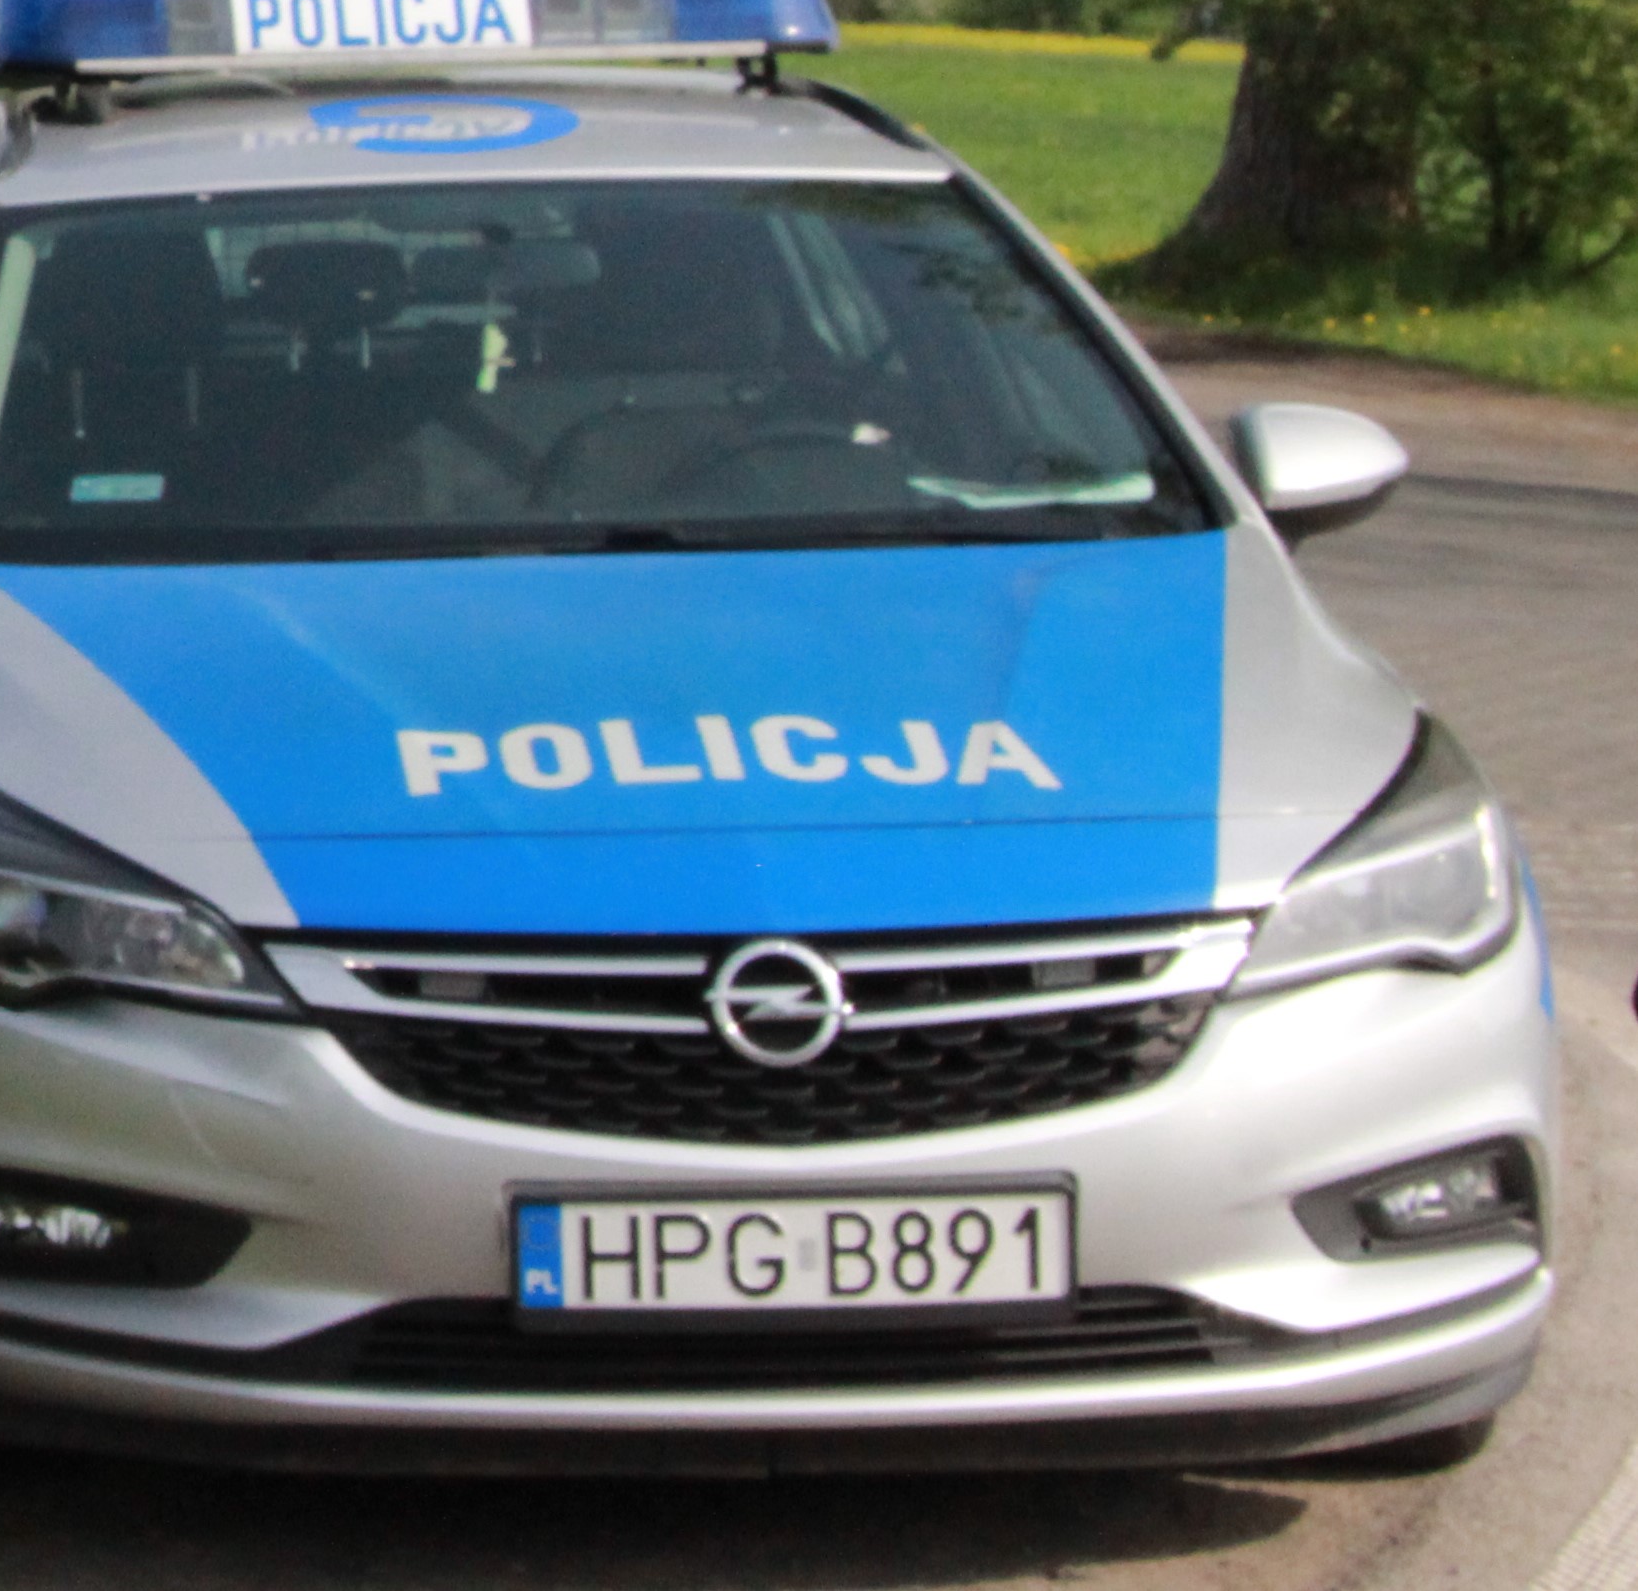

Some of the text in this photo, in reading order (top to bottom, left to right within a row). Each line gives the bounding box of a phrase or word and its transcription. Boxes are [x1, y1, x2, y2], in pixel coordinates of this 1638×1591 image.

[396, 714, 1063, 797] POLICJA
[526, 1268, 558, 1295] PL
[580, 1207, 1041, 1300] HPG B891
